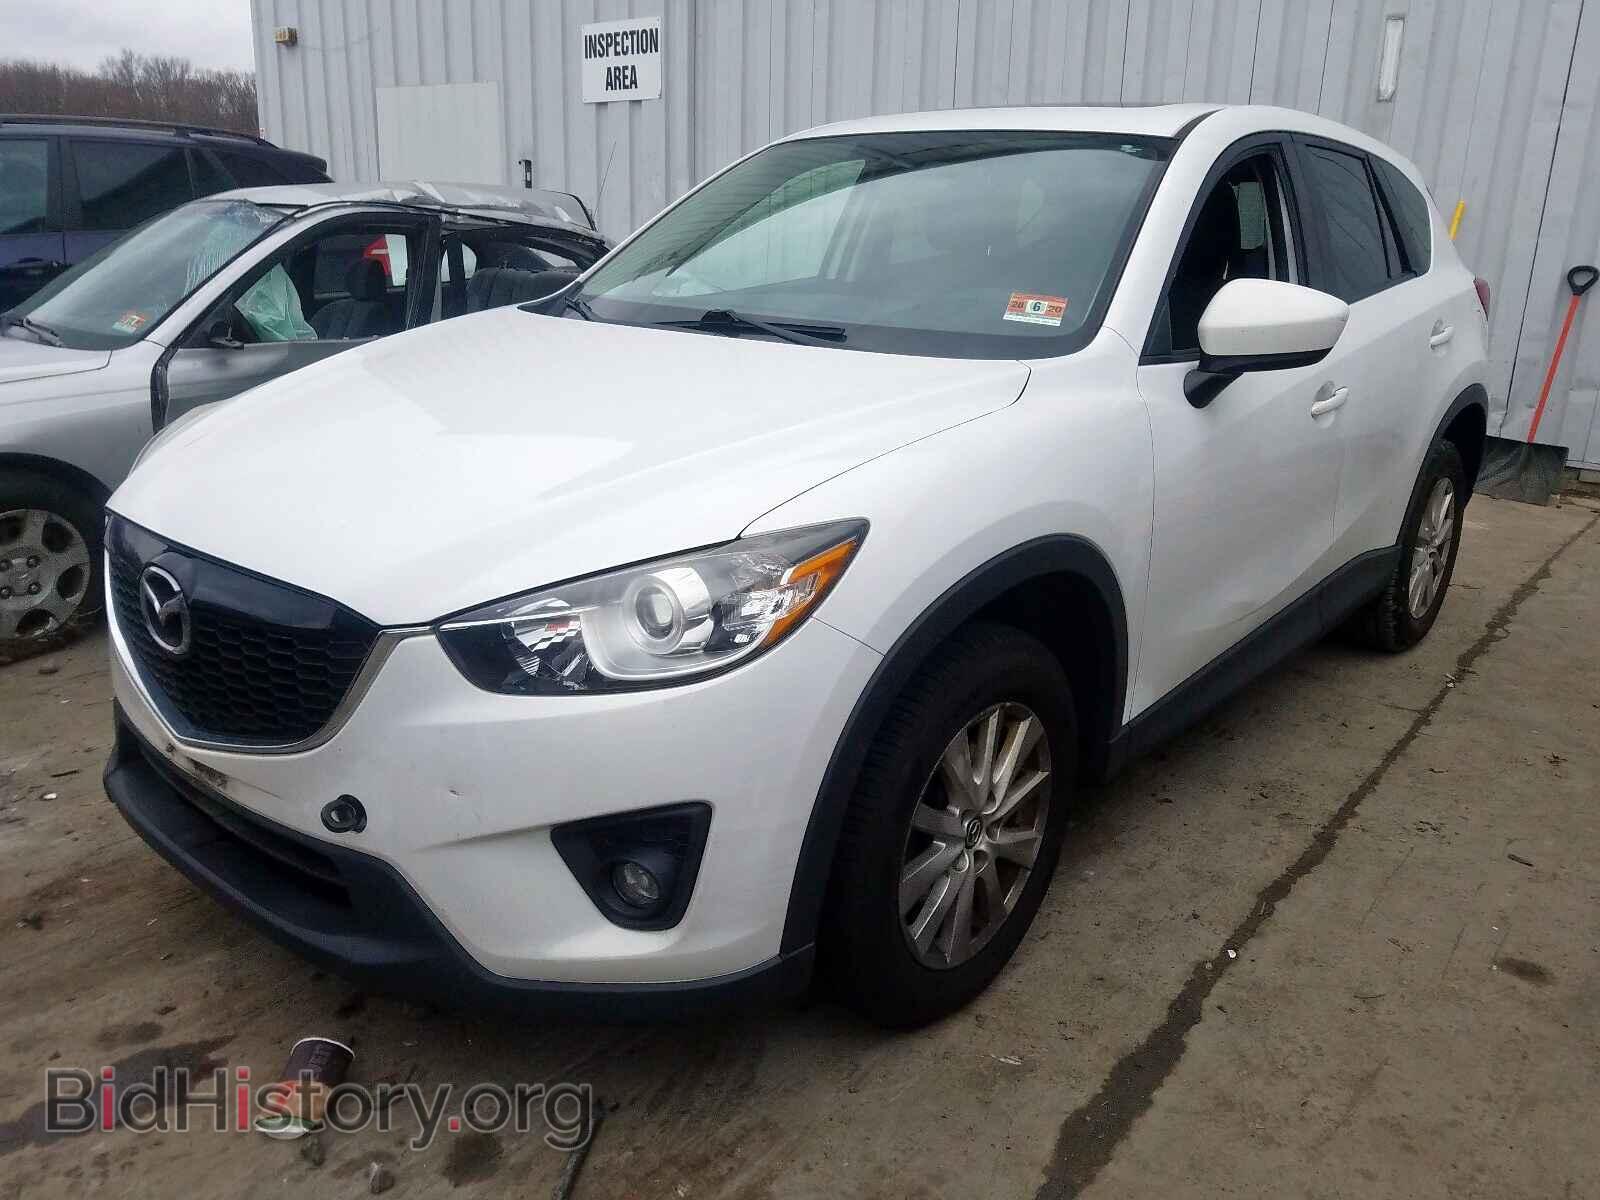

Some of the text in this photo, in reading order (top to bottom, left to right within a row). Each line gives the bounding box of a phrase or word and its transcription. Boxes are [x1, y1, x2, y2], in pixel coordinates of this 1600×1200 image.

[584, 27, 659, 59] INSPECTION
[605, 64, 638, 91] AREA
[1033, 302, 1041, 312] 6
[1048, 304, 1063, 313] 20
